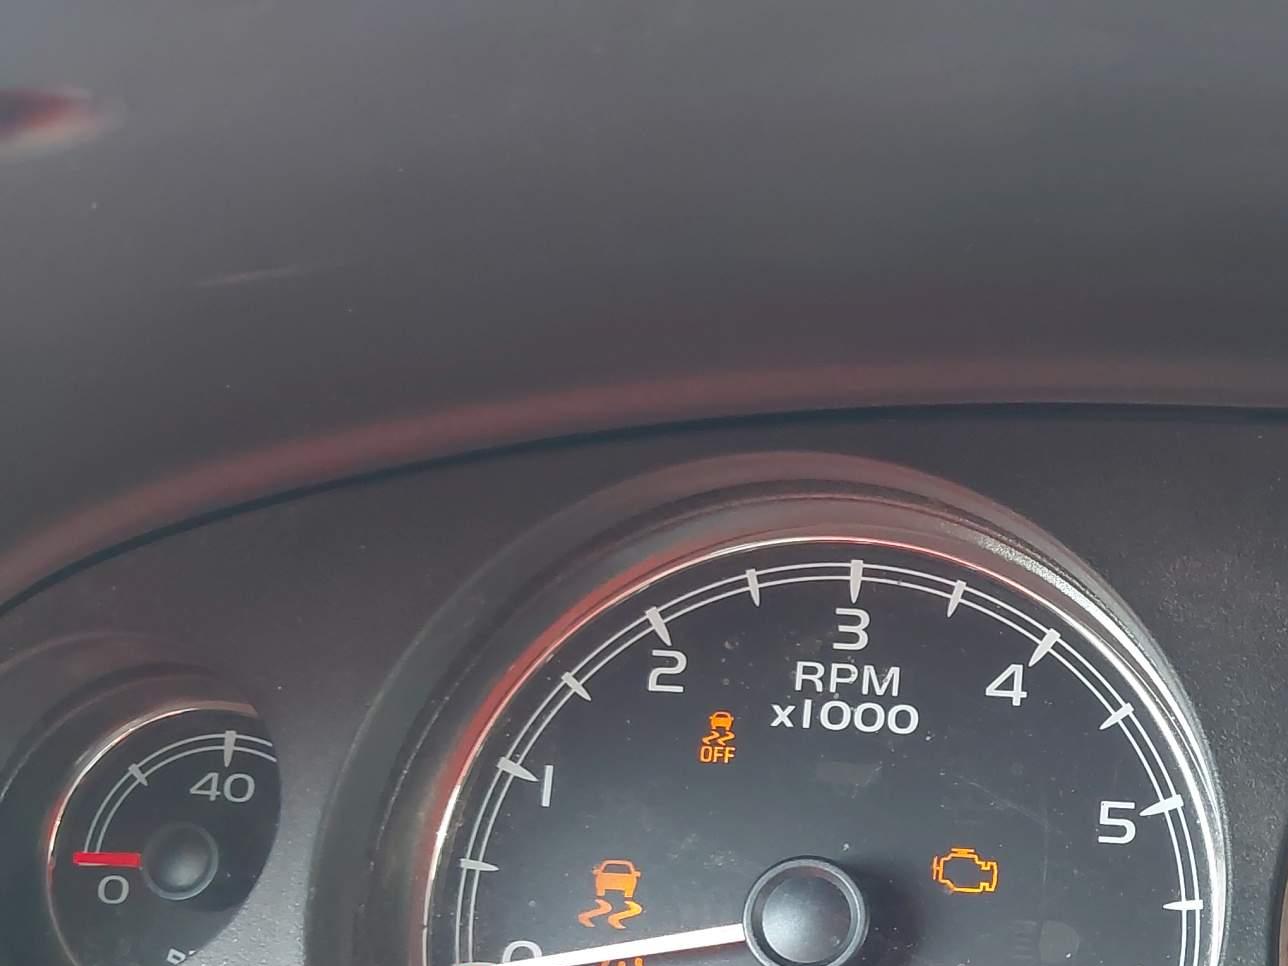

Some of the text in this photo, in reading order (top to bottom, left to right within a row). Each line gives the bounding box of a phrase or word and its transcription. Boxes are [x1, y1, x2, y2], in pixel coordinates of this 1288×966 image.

[832, 607, 870, 651] 3
[647, 649, 687, 693] 2
[794, 661, 901, 698] RPM
[985, 663, 1028, 707] 4
[770, 699, 919, 735] x1000
[699, 745, 736, 764] OFF
[189, 772, 256, 803] 40
[541, 764, 554, 807] 1
[1097, 800, 1136, 844] 5
[97, 875, 130, 904] 0
